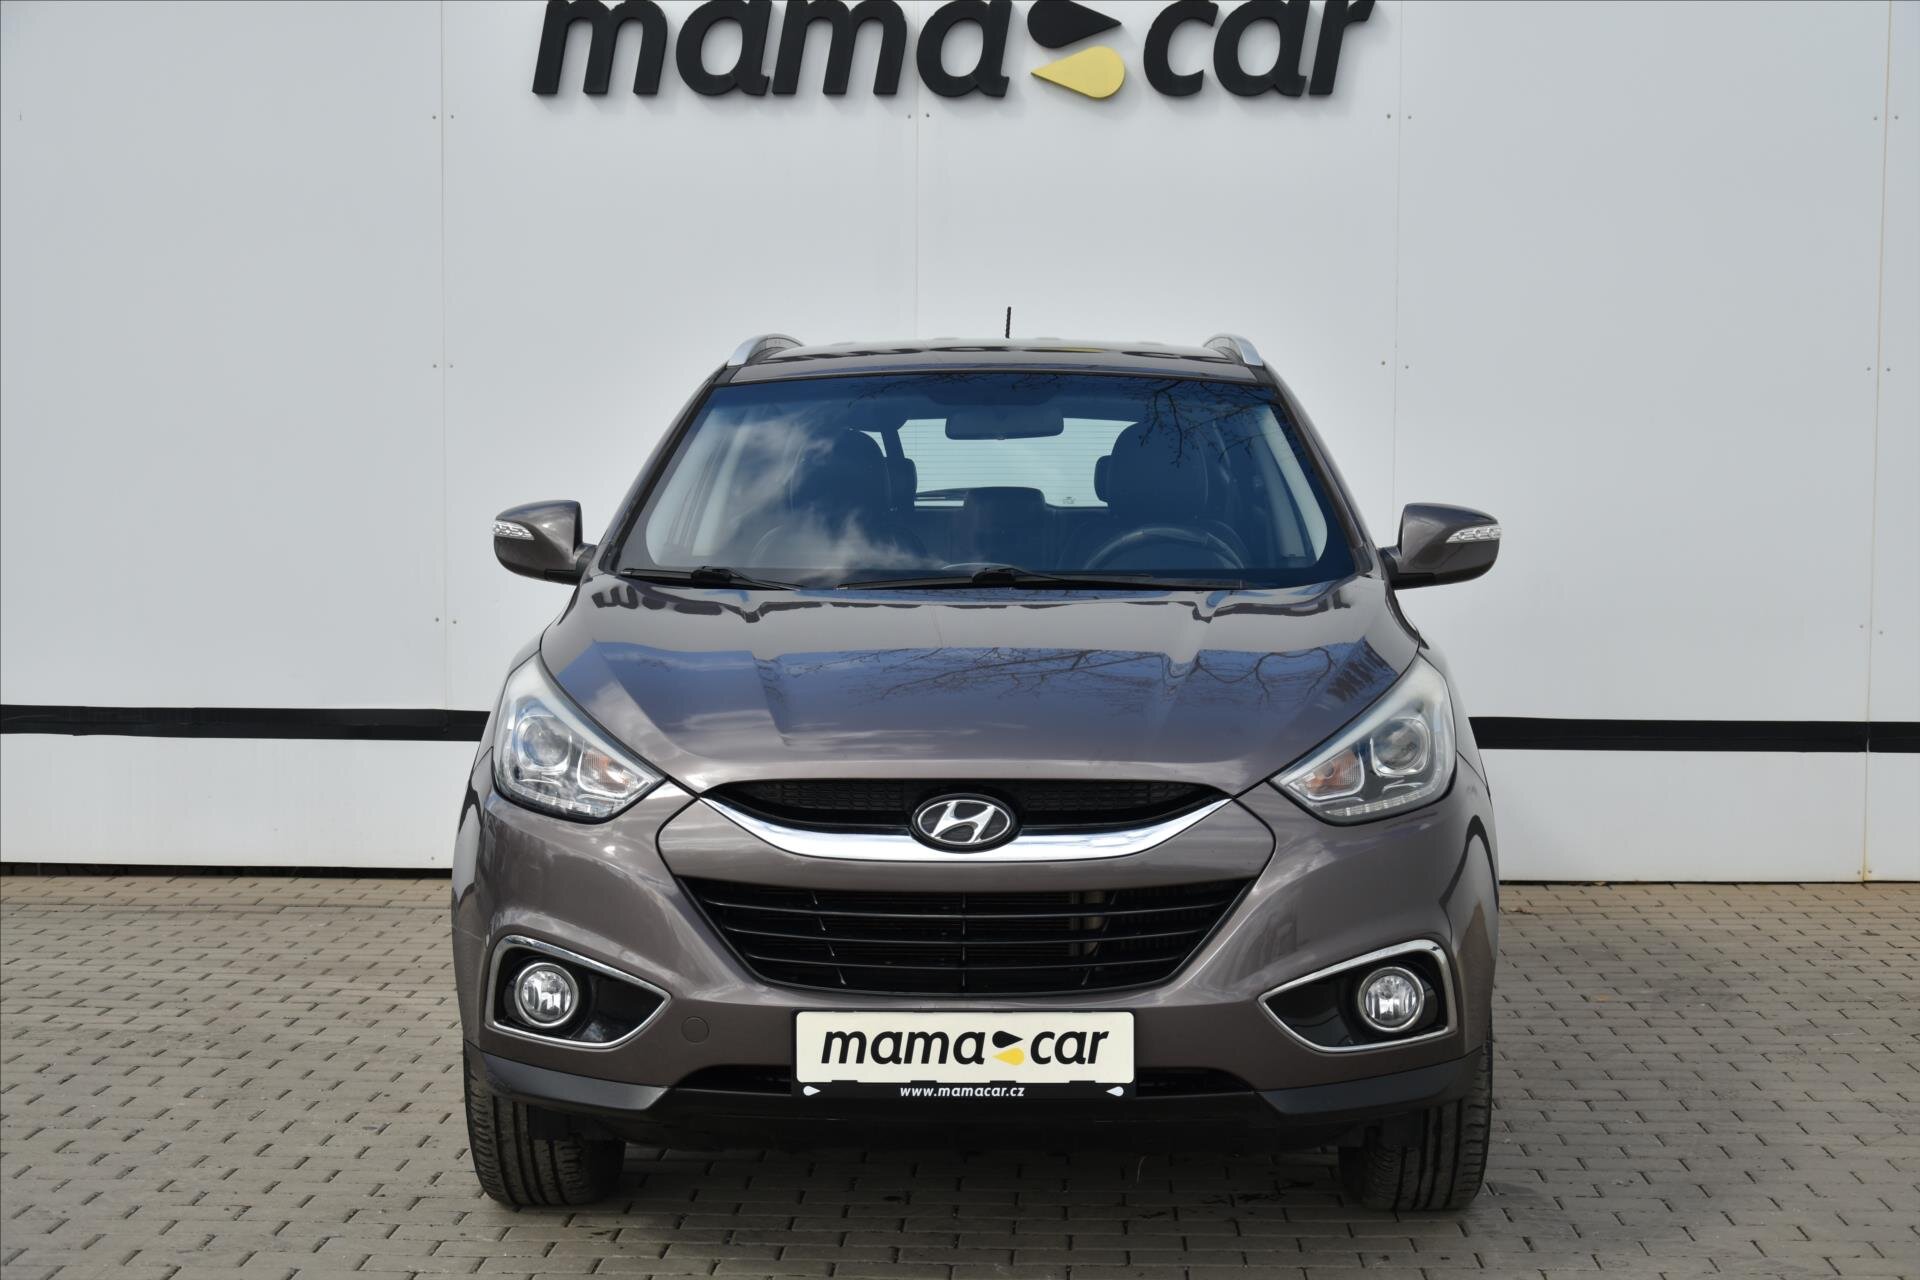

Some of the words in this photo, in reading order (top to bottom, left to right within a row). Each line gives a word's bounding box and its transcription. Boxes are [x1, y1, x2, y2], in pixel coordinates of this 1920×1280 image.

[532, 0, 1012, 98] mama
[1144, 0, 1376, 98] car
[821, 1031, 986, 1065] mama
[1030, 1031, 1110, 1065] car
[899, 1085, 1026, 1098] www.mamacar.cz
